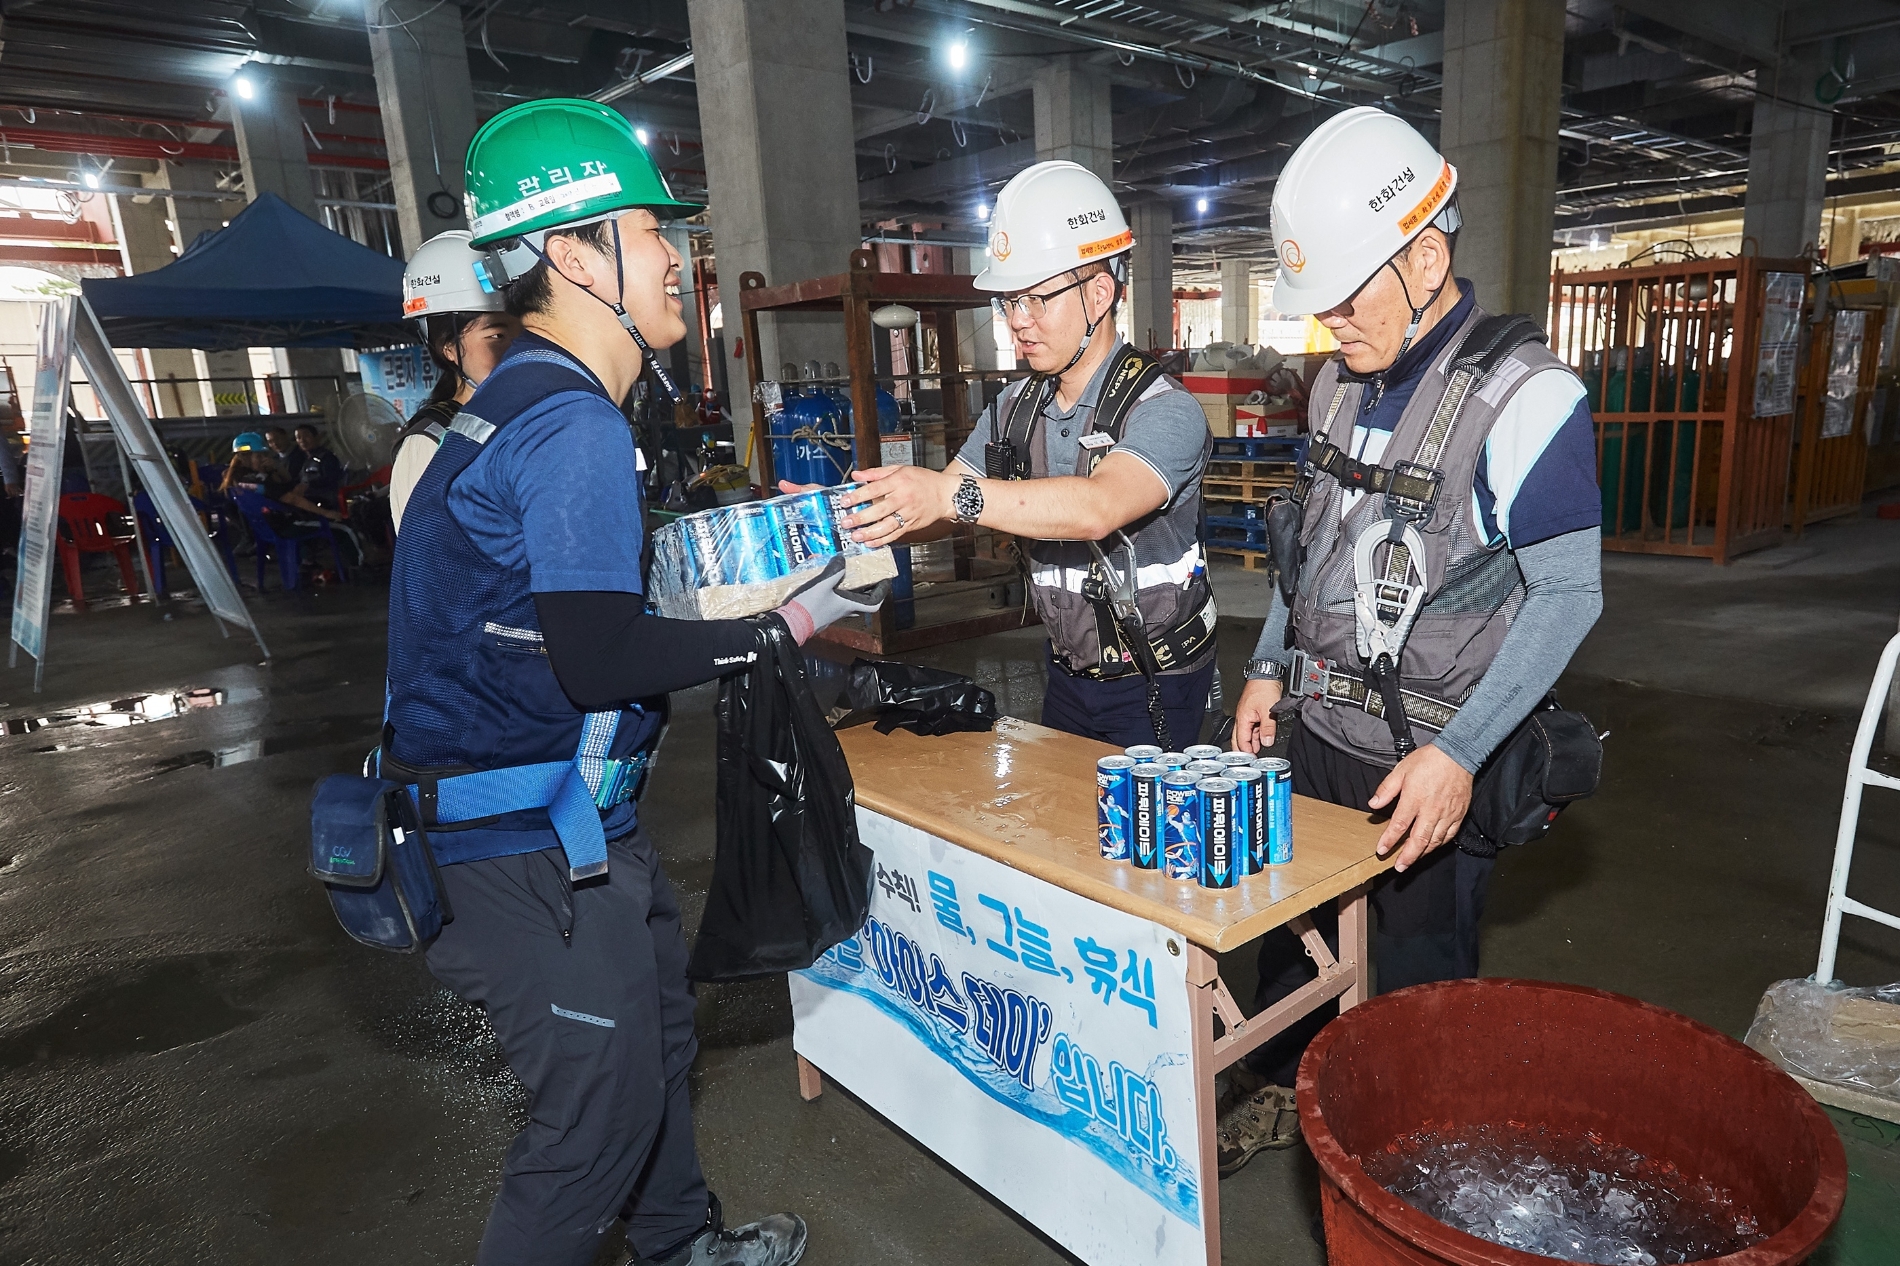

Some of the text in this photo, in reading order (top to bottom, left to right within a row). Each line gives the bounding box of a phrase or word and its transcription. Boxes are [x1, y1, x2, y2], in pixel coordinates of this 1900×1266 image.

[1368, 166, 1416, 213] 한화건설
[1067, 209, 1106, 230] 한화건설
[410, 274, 441, 289] 한화건설
[384, 353, 416, 391] 근로자
[656, 366, 674, 392] SAFETY
[1108, 369, 1129, 398] NEPA
[1166, 789, 1197, 798] POWER
[1138, 781, 1150, 857] 파워에이드
[1213, 797, 1226, 875] 파워에이드
[1255, 782, 1264, 861] 파워에이드
[877, 862, 1158, 1029] 수칙! 물, 그늘, 휴식
[1051, 1032, 1178, 1171] 입니다.
